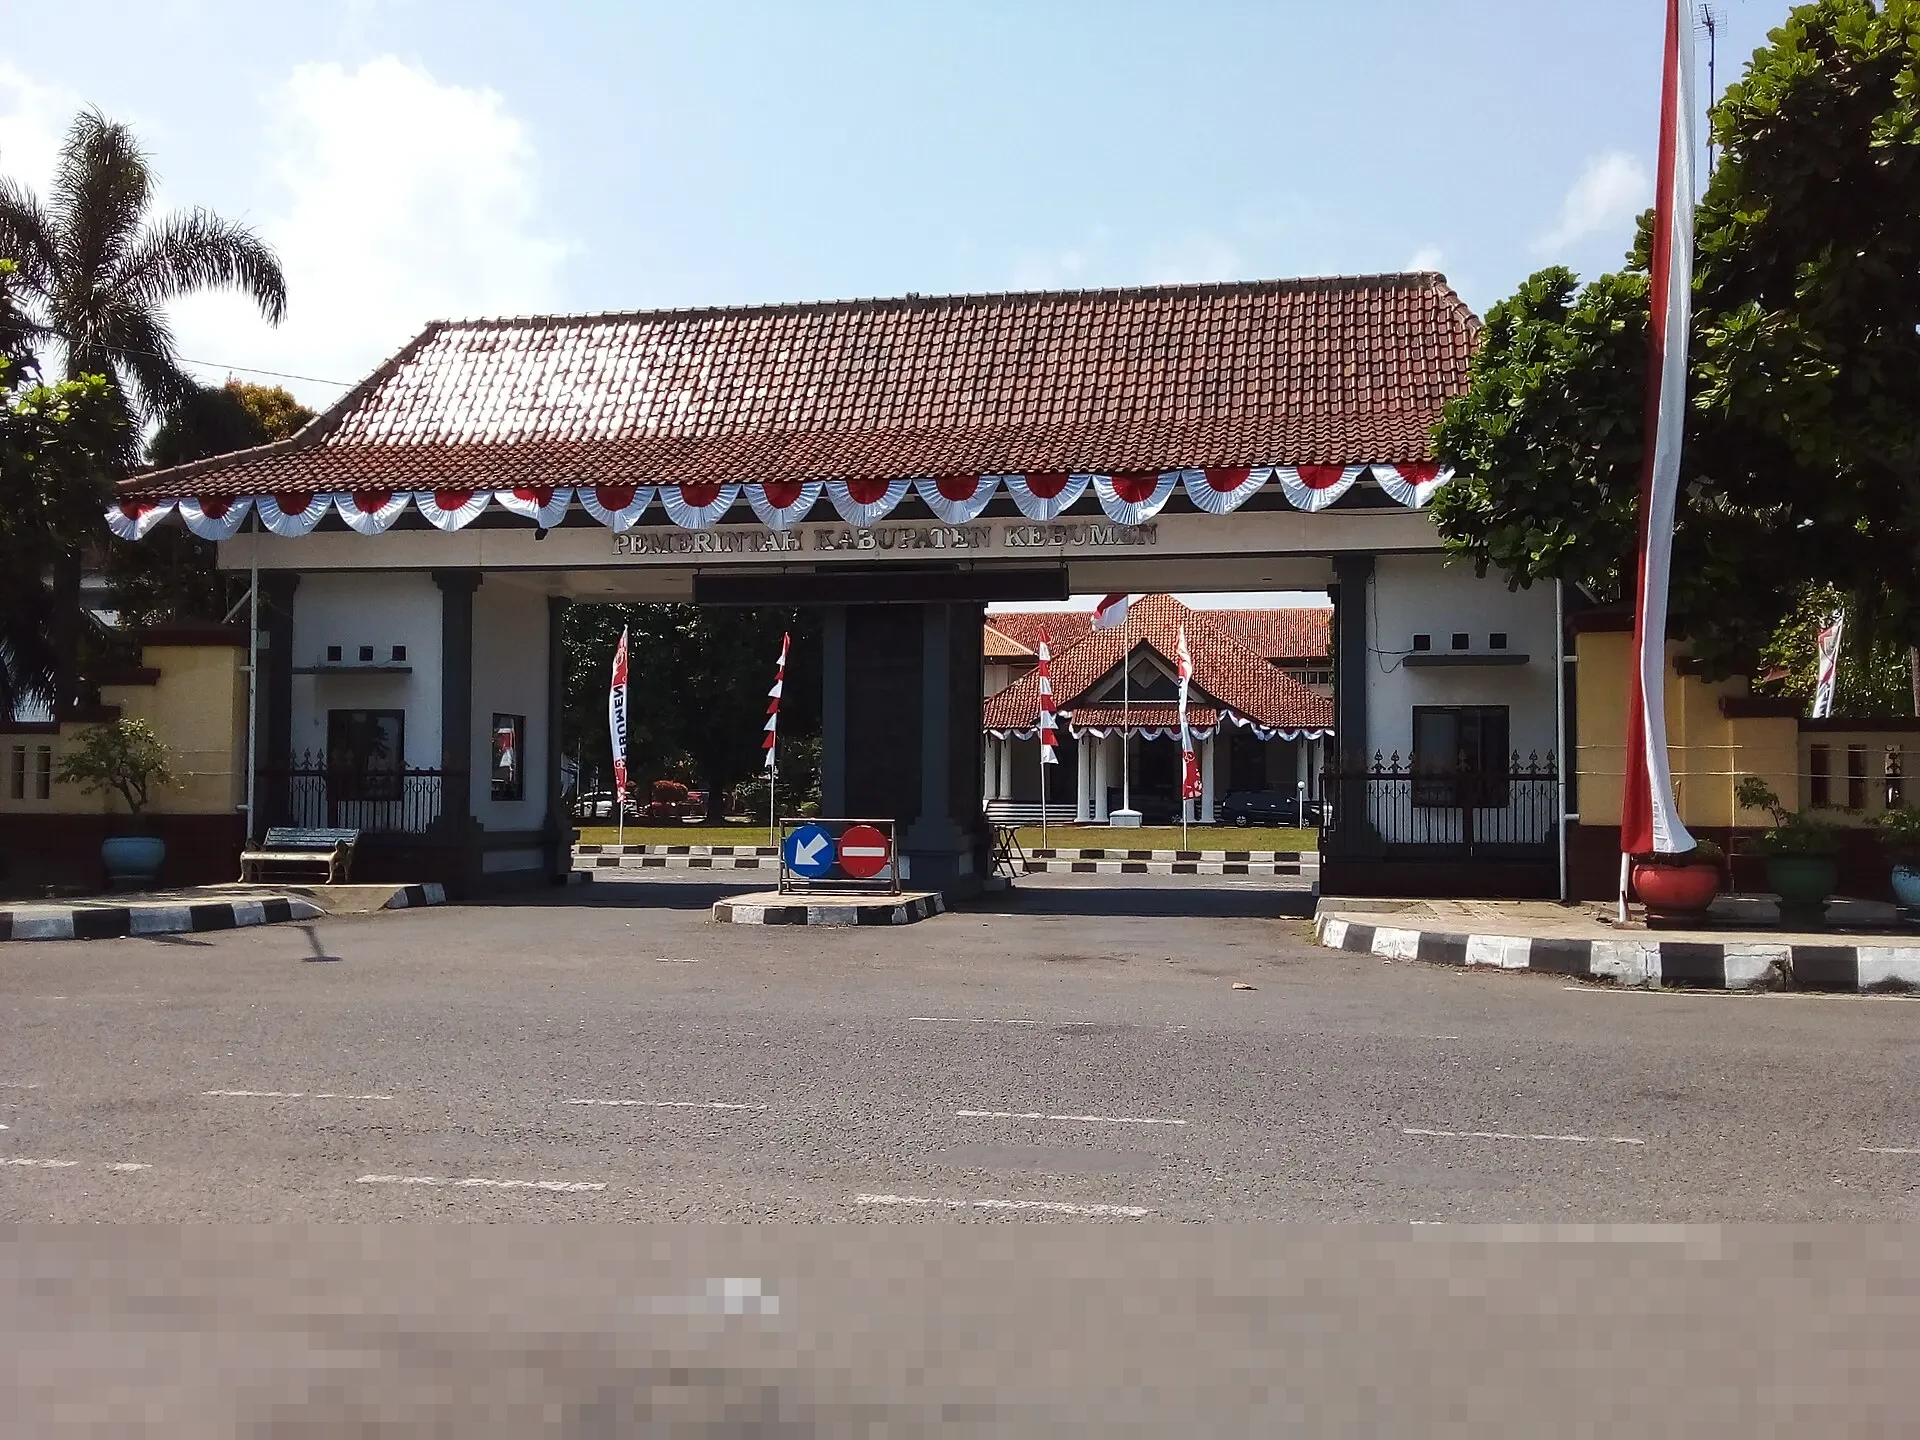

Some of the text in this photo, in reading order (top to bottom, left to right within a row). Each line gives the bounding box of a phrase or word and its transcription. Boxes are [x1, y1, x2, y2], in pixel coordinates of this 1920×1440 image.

[612, 523, 1159, 555] PEMERINTAH KABUPATEN KEBUMEN
